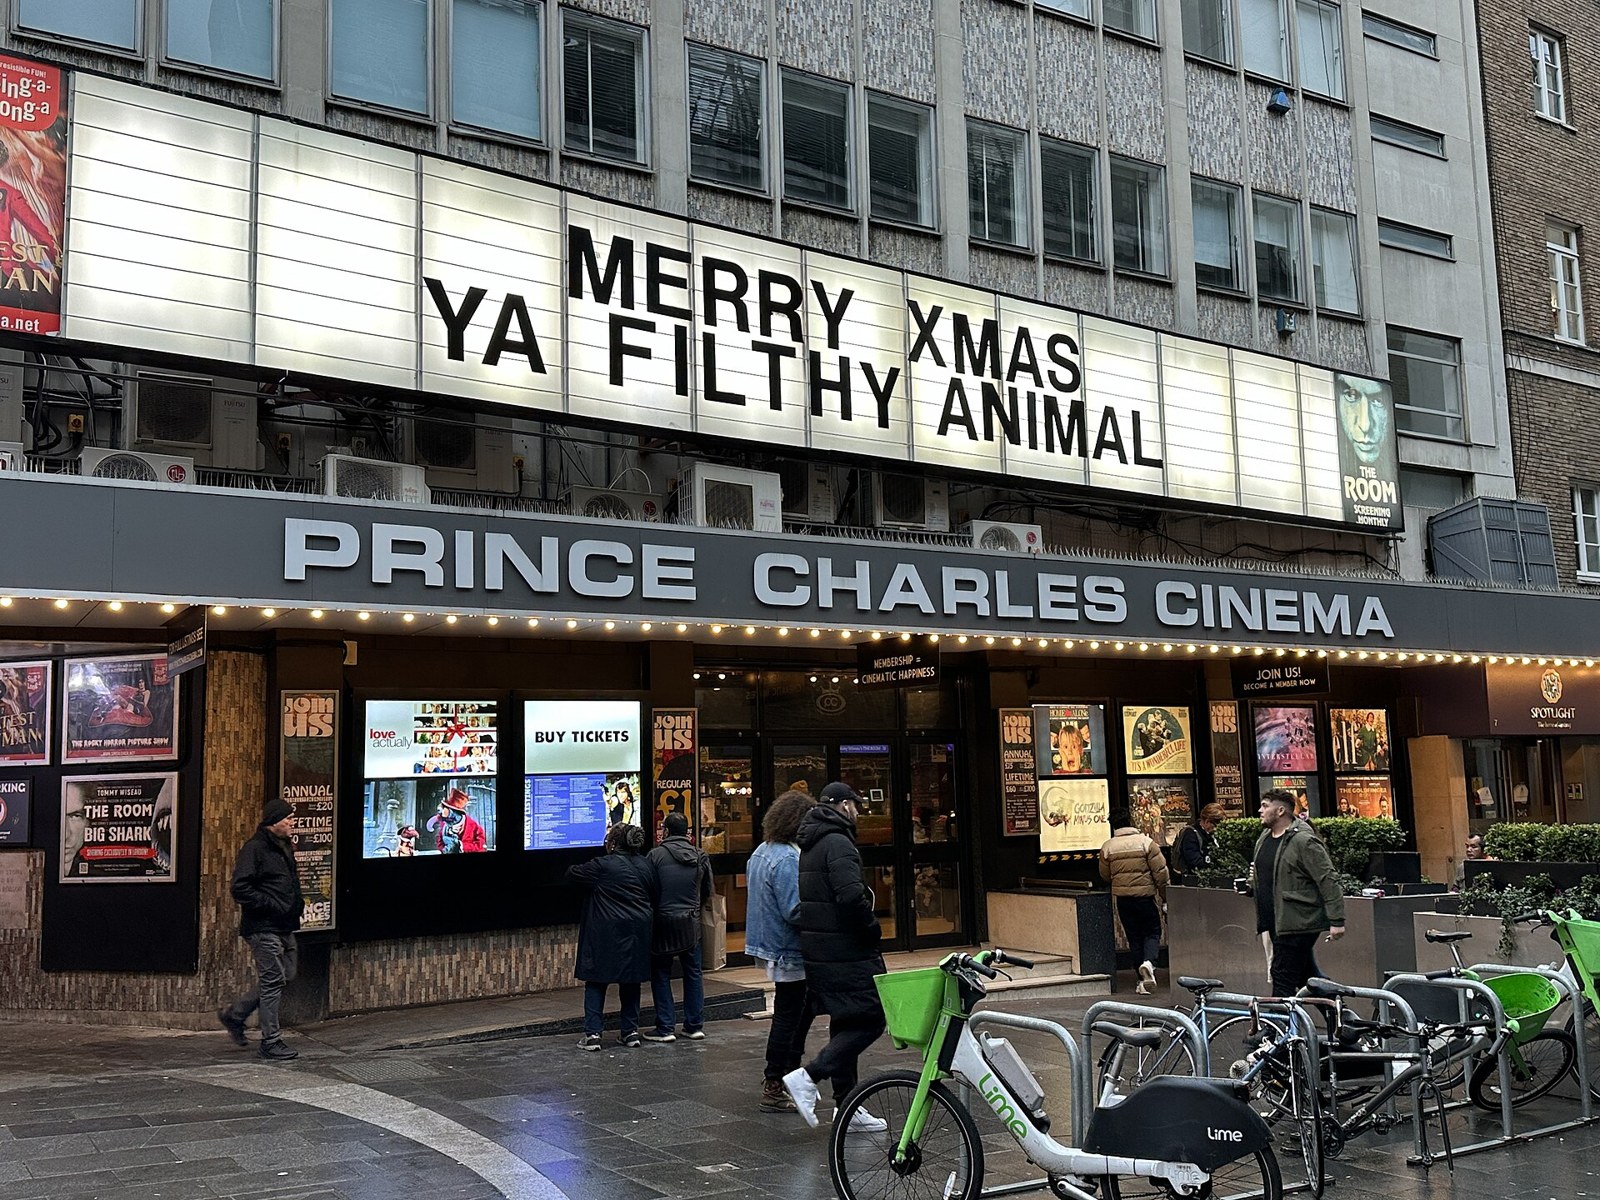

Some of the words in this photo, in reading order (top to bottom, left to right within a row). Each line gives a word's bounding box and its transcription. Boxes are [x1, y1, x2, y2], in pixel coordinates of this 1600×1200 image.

[31, 69, 47, 78] FUN!
[0, 73, 52, 98] ing-a-
[0, 266, 54, 295] AN
[568, 224, 854, 350] MERRY
[907, 299, 1081, 393] XMAS
[423, 277, 547, 375] YA
[609, 312, 900, 429] FILTHY
[937, 377, 1164, 469] ANIMAL
[1359, 465, 1377, 479] THE
[1344, 475, 1397, 504] ROOM
[1353, 504, 1391, 518] SCREENING
[284, 517, 697, 601] PRINCE
[753, 551, 1128, 625] CHARLES
[1155, 580, 1394, 638] CINEMA
[873, 655, 914, 669] MEMBERSHIP
[861, 671, 897, 684] CINEMATIC
[899, 667, 935, 680] HAPPINESS
[1256, 668, 1281, 680] JOIN
[1285, 666, 1301, 678] US!
[1244, 682, 1267, 690] BECOME
[1275, 680, 1298, 688] MEMBER
[1530, 707, 1576, 719] SPOTLIGHT
[369, 729, 396, 739] love
[535, 731, 566, 743] BUY
[572, 730, 629, 743] TICKETS
[72, 740, 83, 748] THE
[104, 738, 127, 747] HORROR
[372, 736, 413, 749] actually
[1004, 750, 1033, 759] ANNUAL
[1005, 773, 1034, 781] LIFETIME
[0, 783, 26, 793] KING
[283, 785, 333, 797] ANNUAL
[656, 780, 692, 789] REGULAR
[120, 788, 142, 796] WISEAU
[84, 804, 109, 819] THE
[113, 803, 152, 818] ROOM
[292, 816, 332, 828] FETIME
[84, 827, 105, 842] BIG
[108, 826, 151, 842] SHARK
[977, 1073, 1027, 1139] Lime
[1207, 1126, 1243, 1142] Lime
